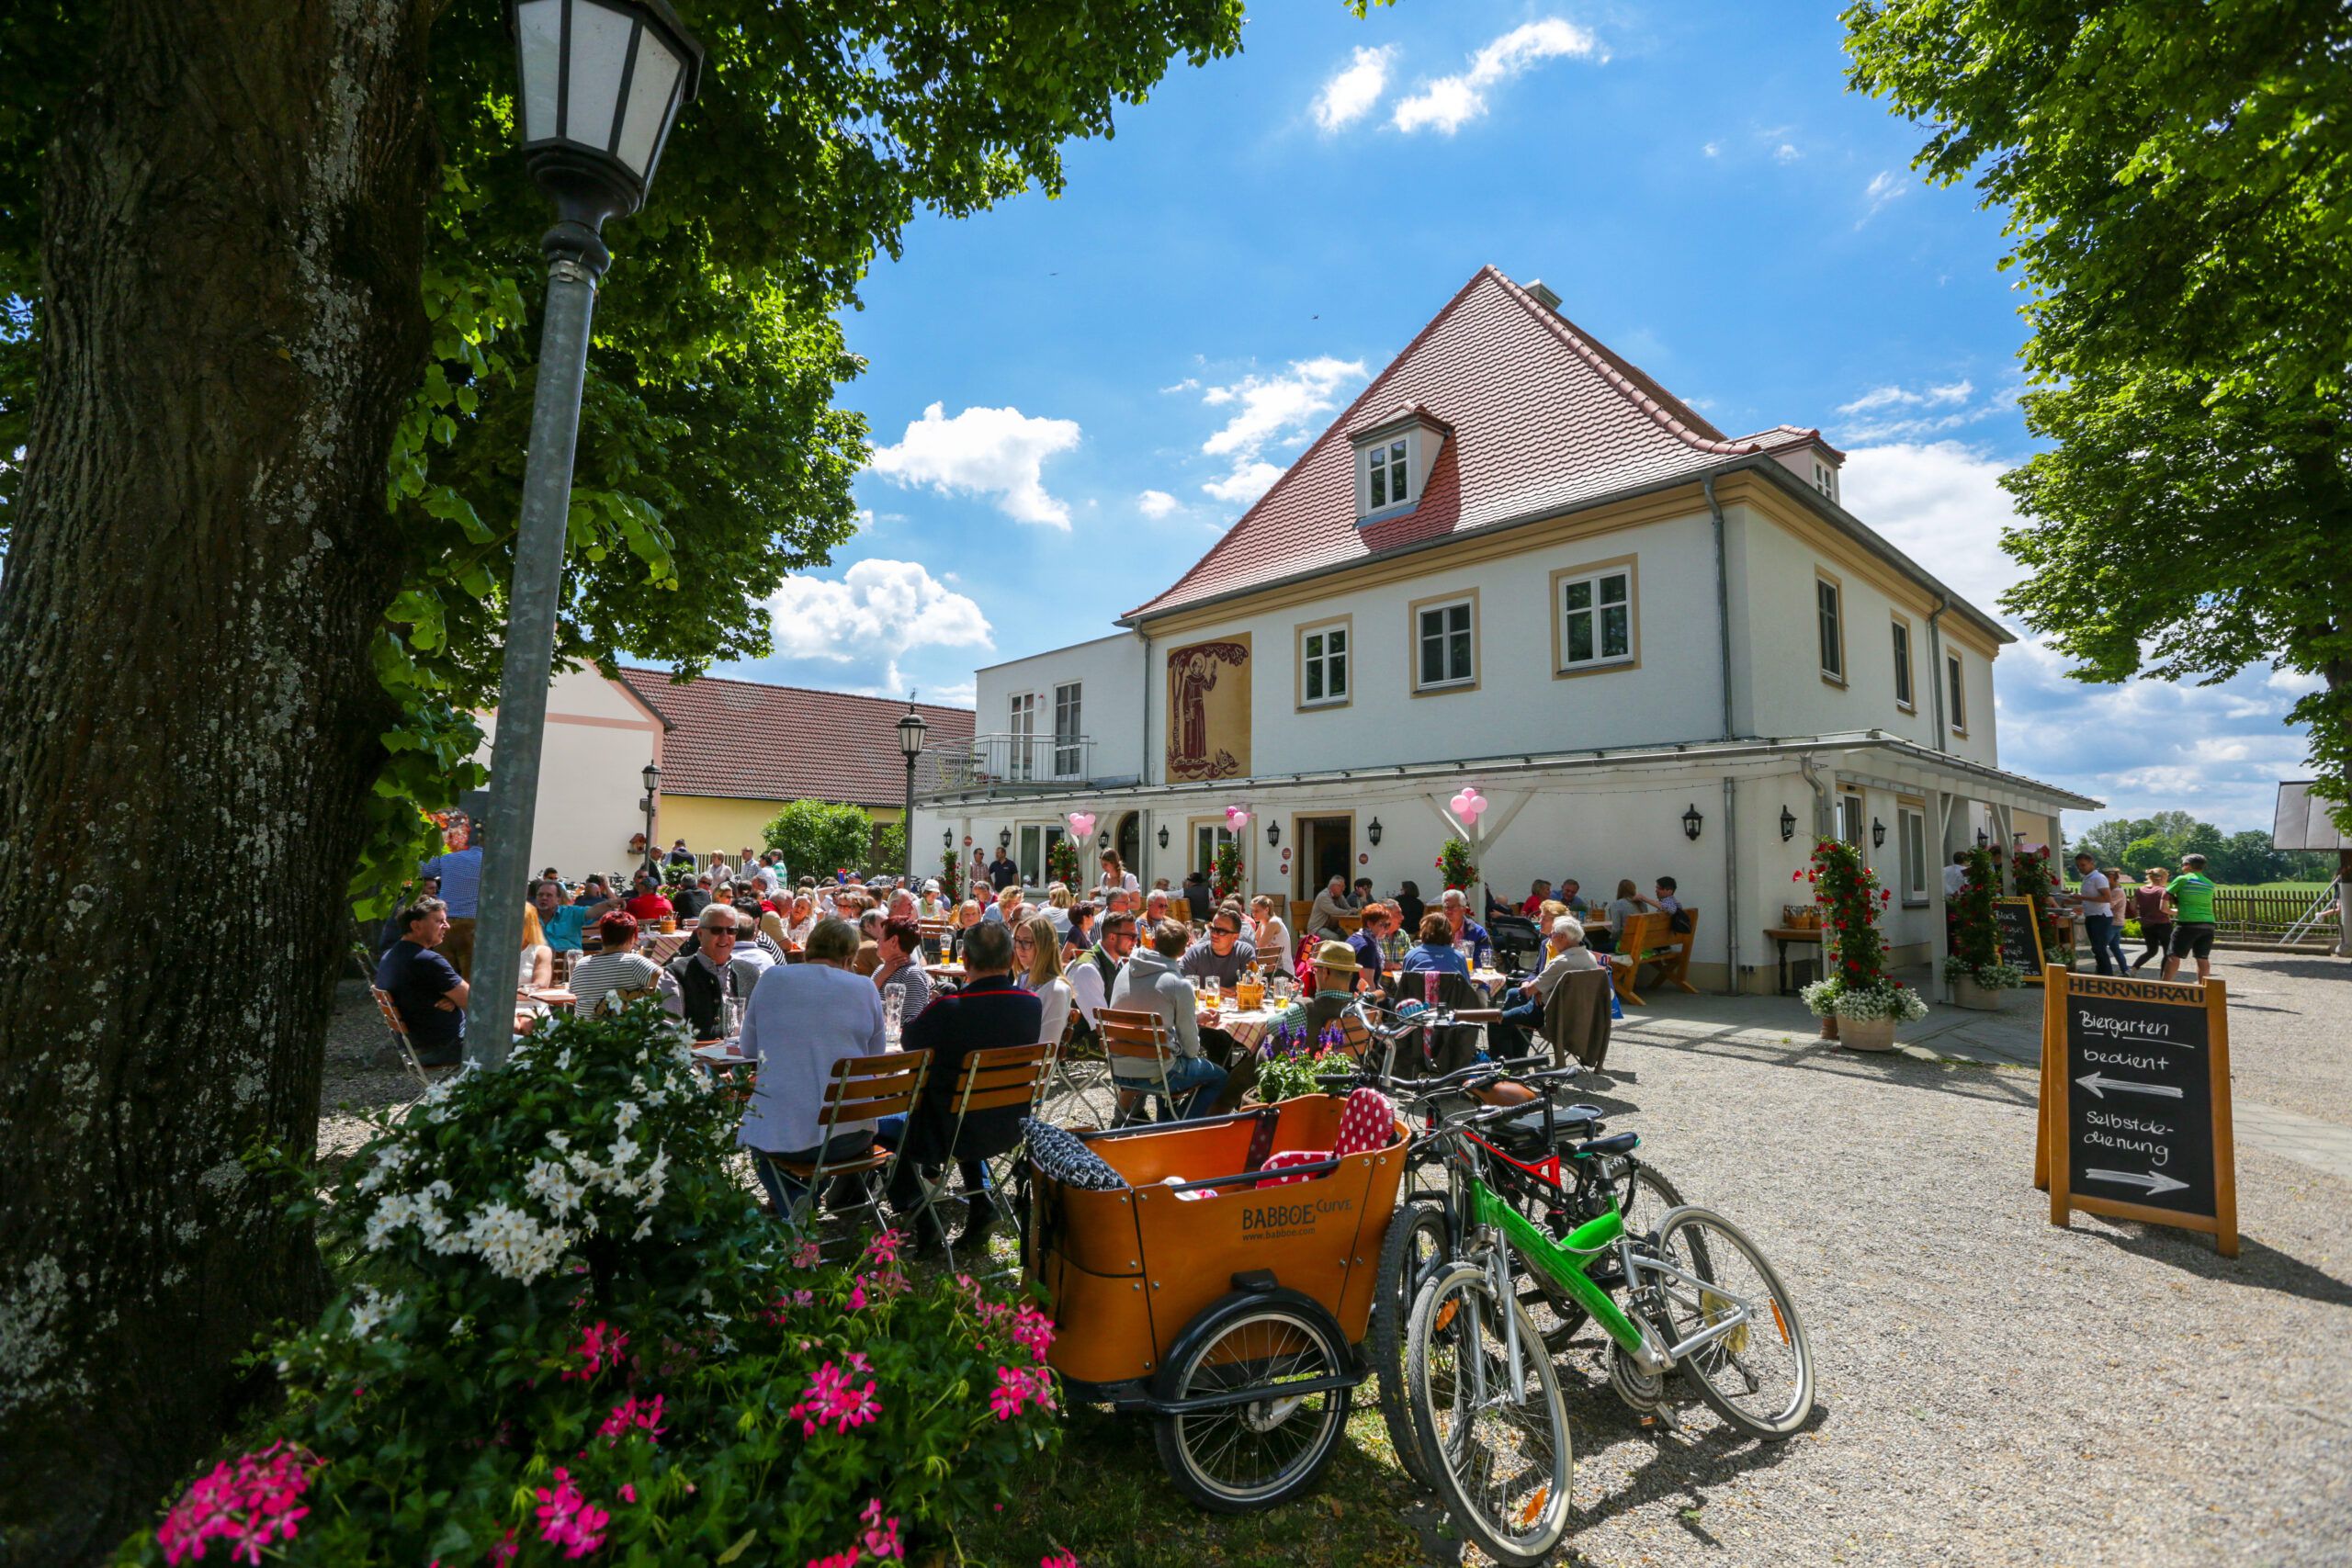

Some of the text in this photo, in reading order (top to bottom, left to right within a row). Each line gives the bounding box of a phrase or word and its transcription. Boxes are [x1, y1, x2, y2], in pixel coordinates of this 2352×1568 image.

[2069, 977, 2204, 1003] HERRNBRÄU
[2079, 1010, 2169, 1038] Biergarten
[2084, 1049, 2169, 1070] bedient
[2084, 1131, 2168, 1166] dienung
[1242, 1204, 1316, 1230] BABBOE
[1242, 1226, 1316, 1241] www.babboe.com
